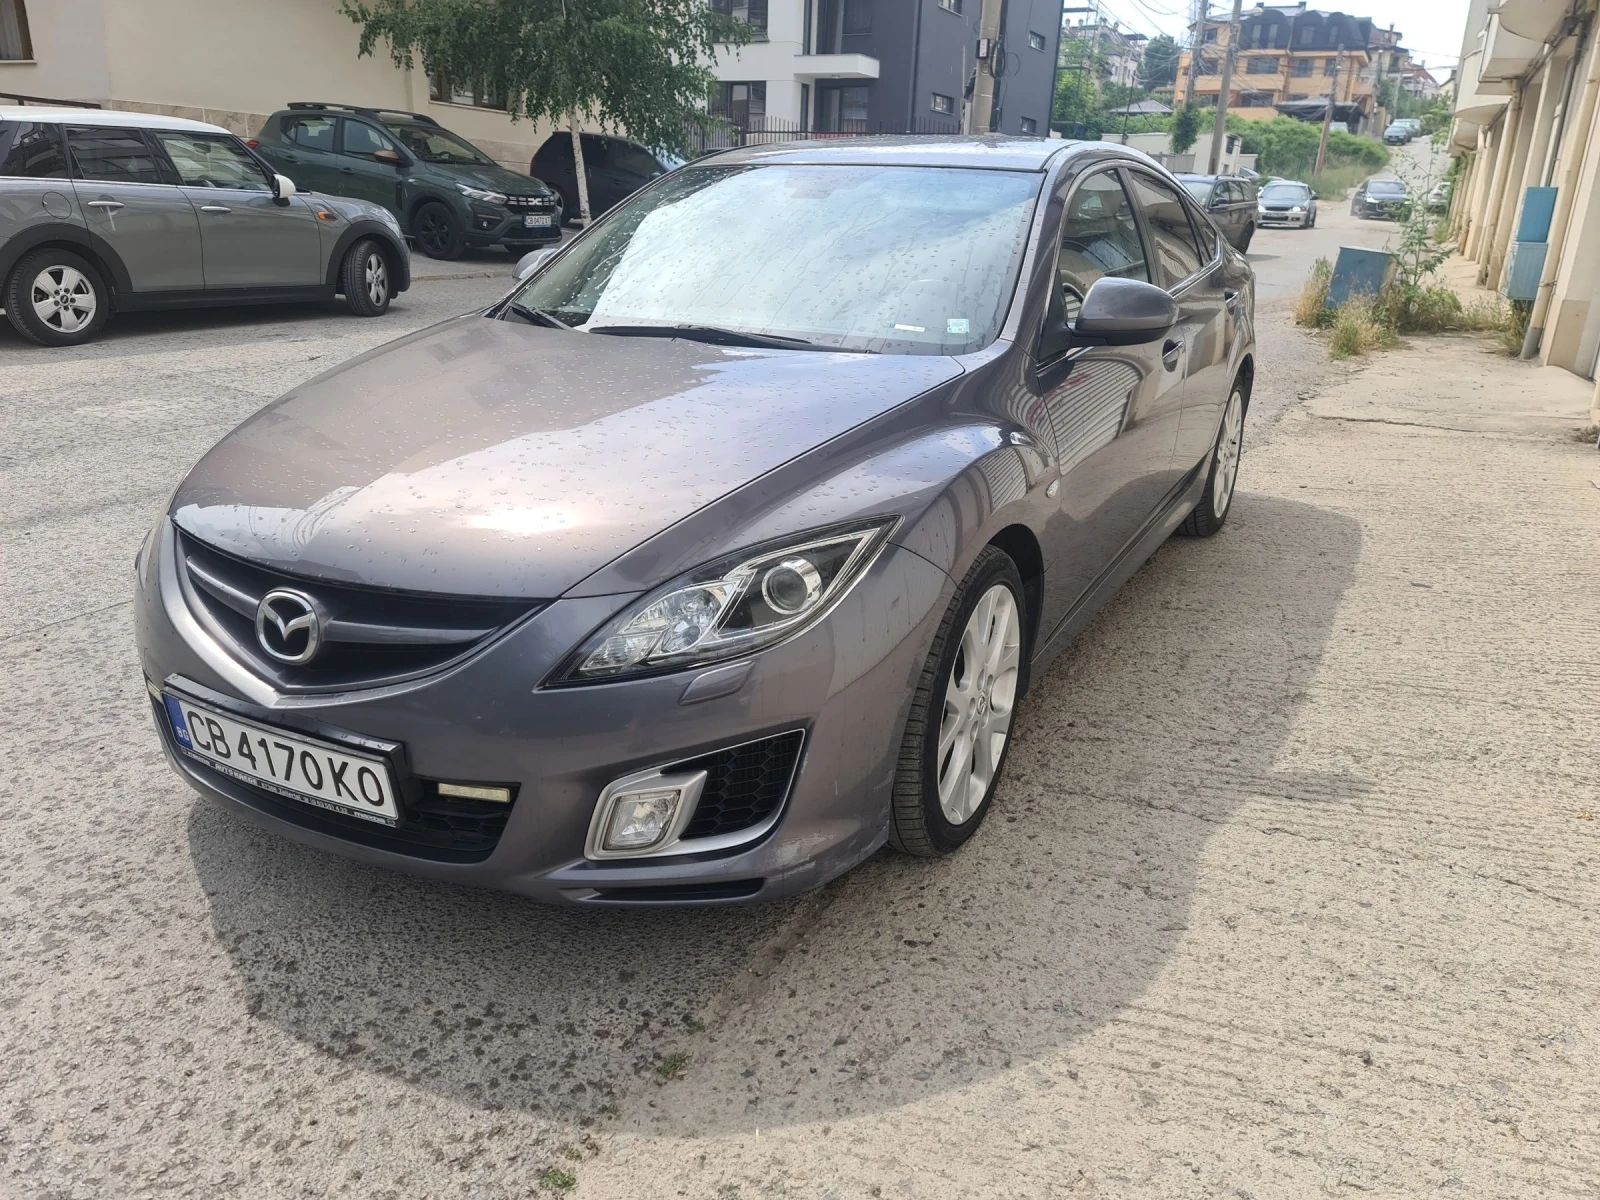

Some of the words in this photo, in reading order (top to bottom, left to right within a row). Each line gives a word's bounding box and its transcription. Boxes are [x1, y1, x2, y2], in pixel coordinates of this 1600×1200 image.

[176, 726, 190, 741] BG
[187, 710, 231, 759] CB
[238, 731, 323, 791] 4170
[328, 757, 385, 807] KO
